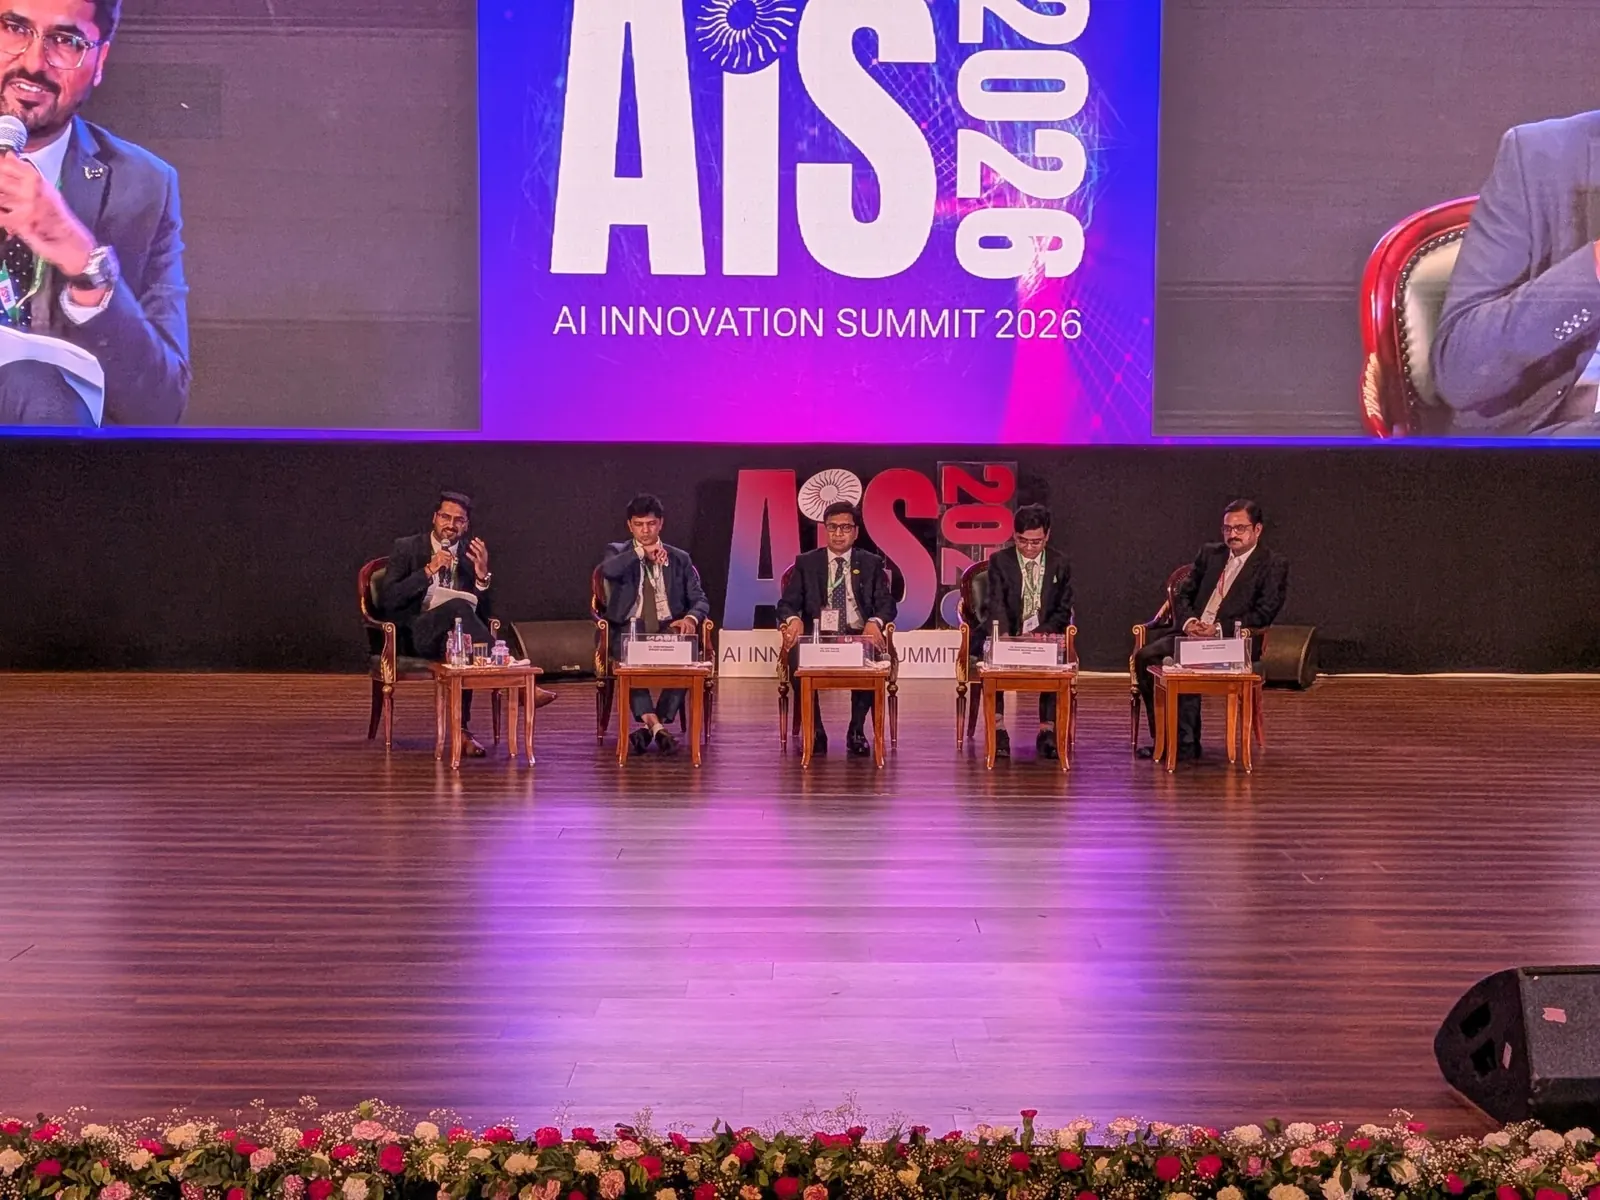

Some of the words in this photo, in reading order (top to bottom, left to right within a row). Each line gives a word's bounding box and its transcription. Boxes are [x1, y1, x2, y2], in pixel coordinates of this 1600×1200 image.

[955, 0, 1090, 280] 2026
[553, 305, 587, 336] AI
[601, 305, 824, 338] INNOVATION
[836, 307, 985, 339] SUMMIT
[995, 308, 1083, 340] 2026
[722, 646, 742, 663] AI
[897, 646, 960, 664] UMMIT
